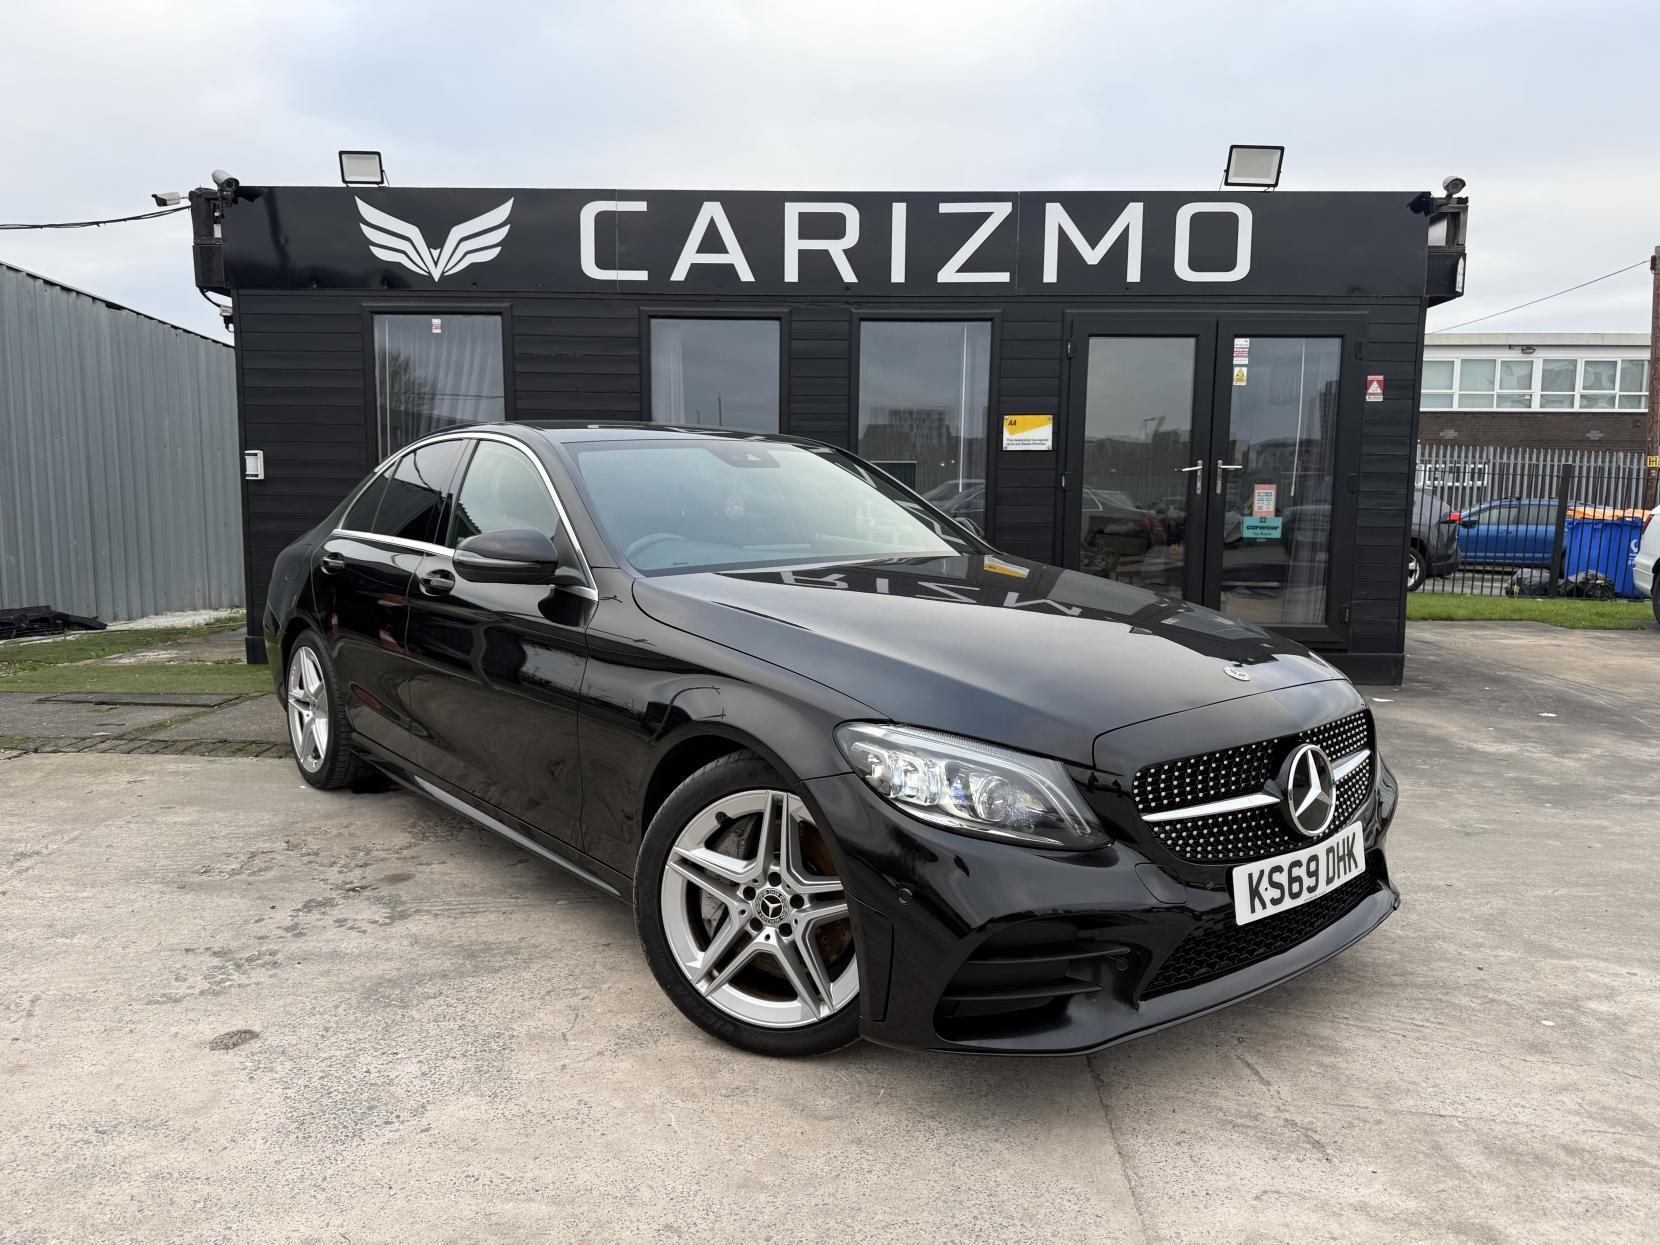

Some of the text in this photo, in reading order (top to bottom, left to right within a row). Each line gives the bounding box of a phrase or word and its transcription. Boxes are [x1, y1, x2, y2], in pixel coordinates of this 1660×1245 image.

[579, 200, 1253, 283] CARIZMO
[1248, 831, 1359, 915] KS69 DHK
